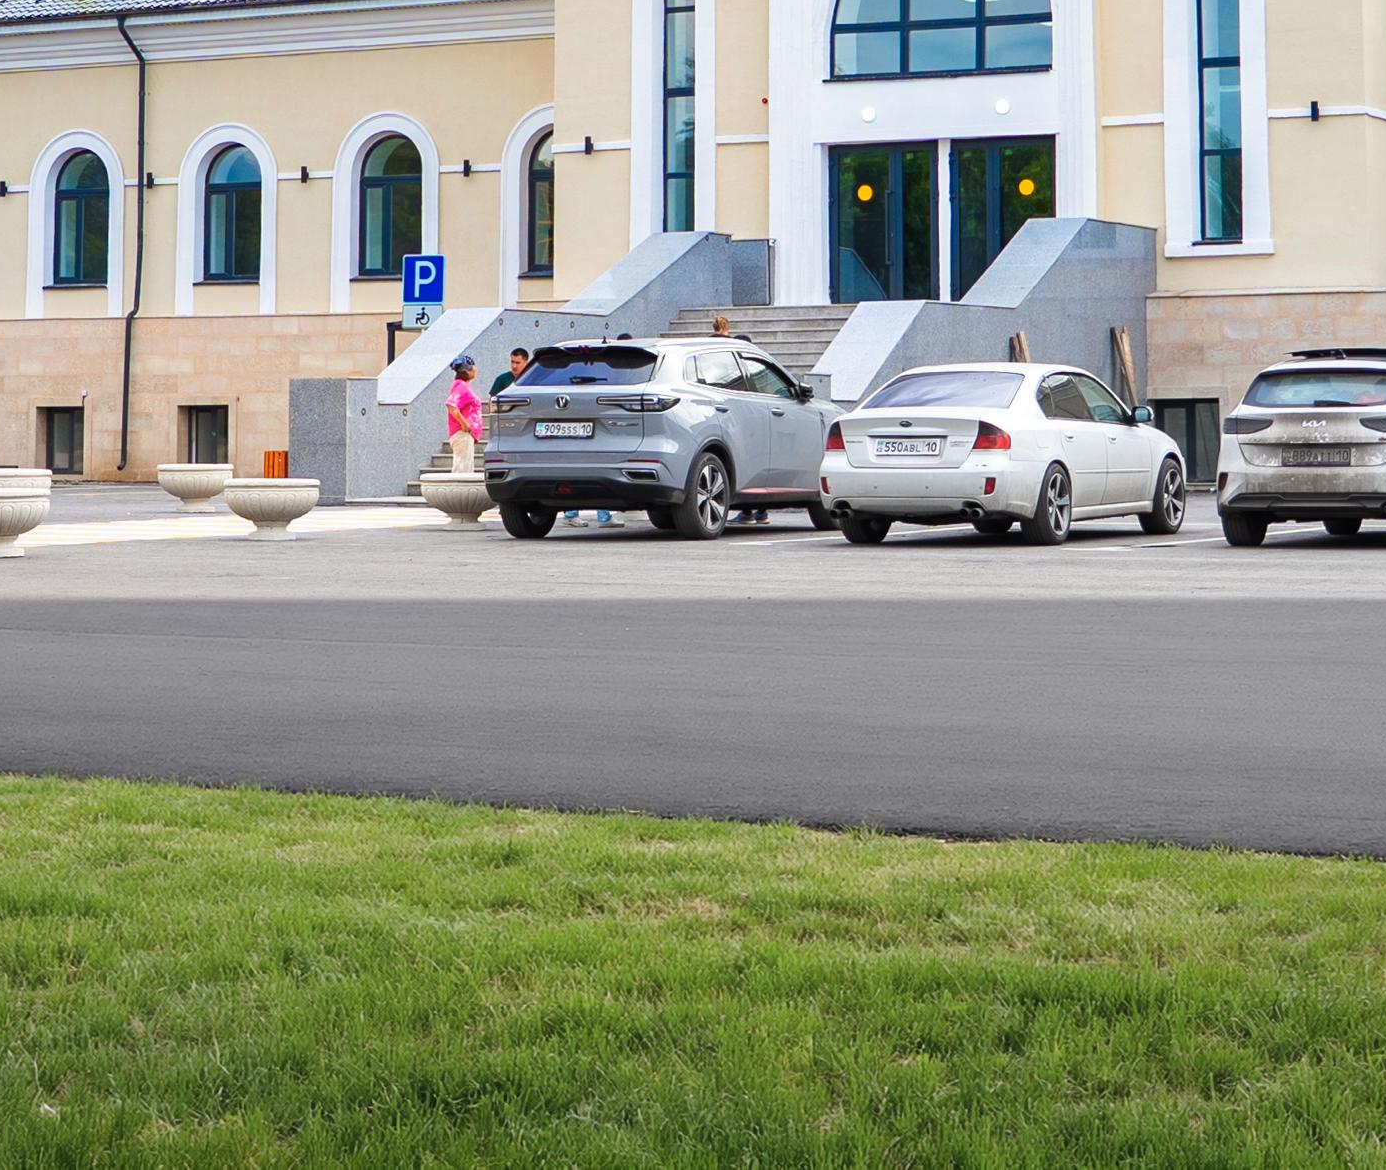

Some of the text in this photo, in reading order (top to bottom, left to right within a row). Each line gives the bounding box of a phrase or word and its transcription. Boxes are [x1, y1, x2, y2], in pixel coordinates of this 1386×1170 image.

[414, 260, 436, 298] P
[581, 424, 592, 435] 10
[884, 441, 921, 453] 550ABL
[925, 442, 938, 453] 10
[1336, 450, 1349, 462] 10
